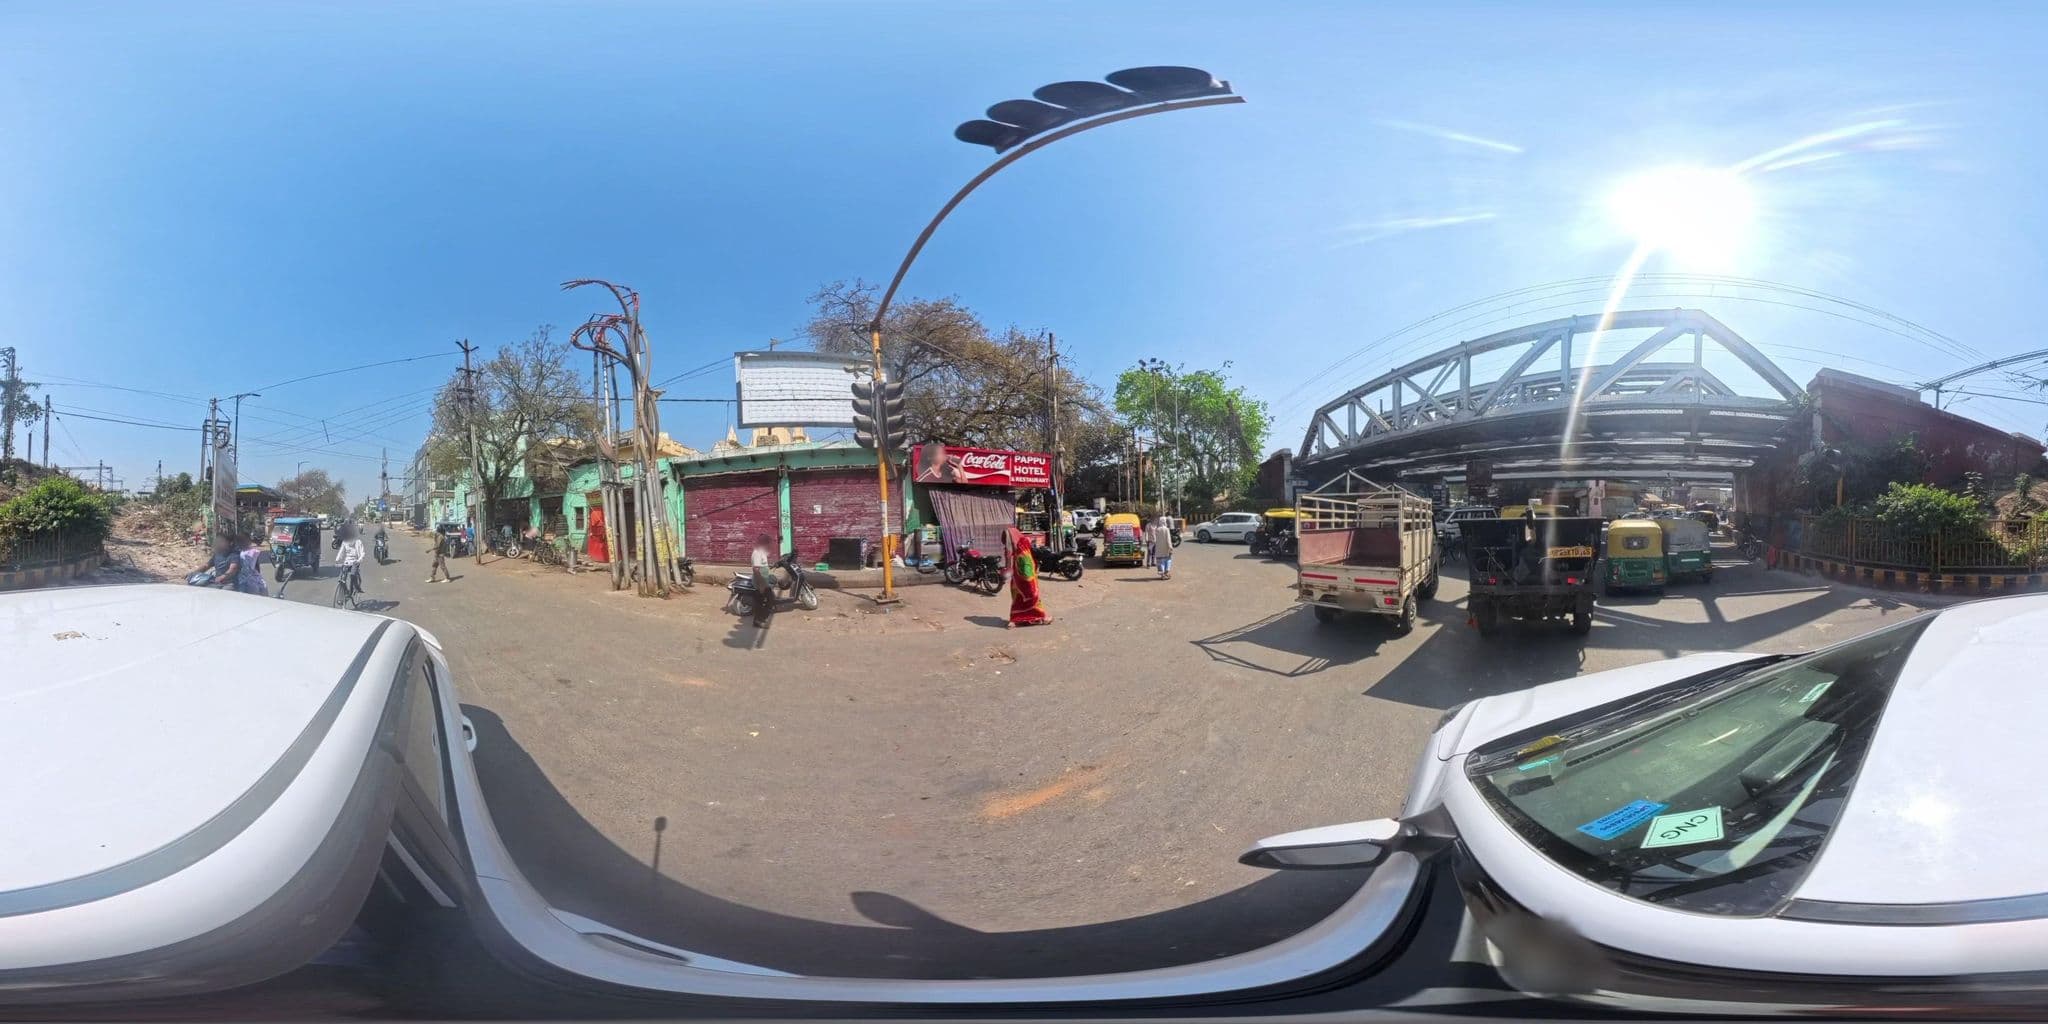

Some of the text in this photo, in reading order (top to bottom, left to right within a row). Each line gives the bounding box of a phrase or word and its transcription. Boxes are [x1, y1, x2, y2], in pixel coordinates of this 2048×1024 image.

[1014, 455, 1046, 465] PAPPU
[1014, 466, 1046, 476] HOTEL
[1661, 815, 1708, 839] CNG
